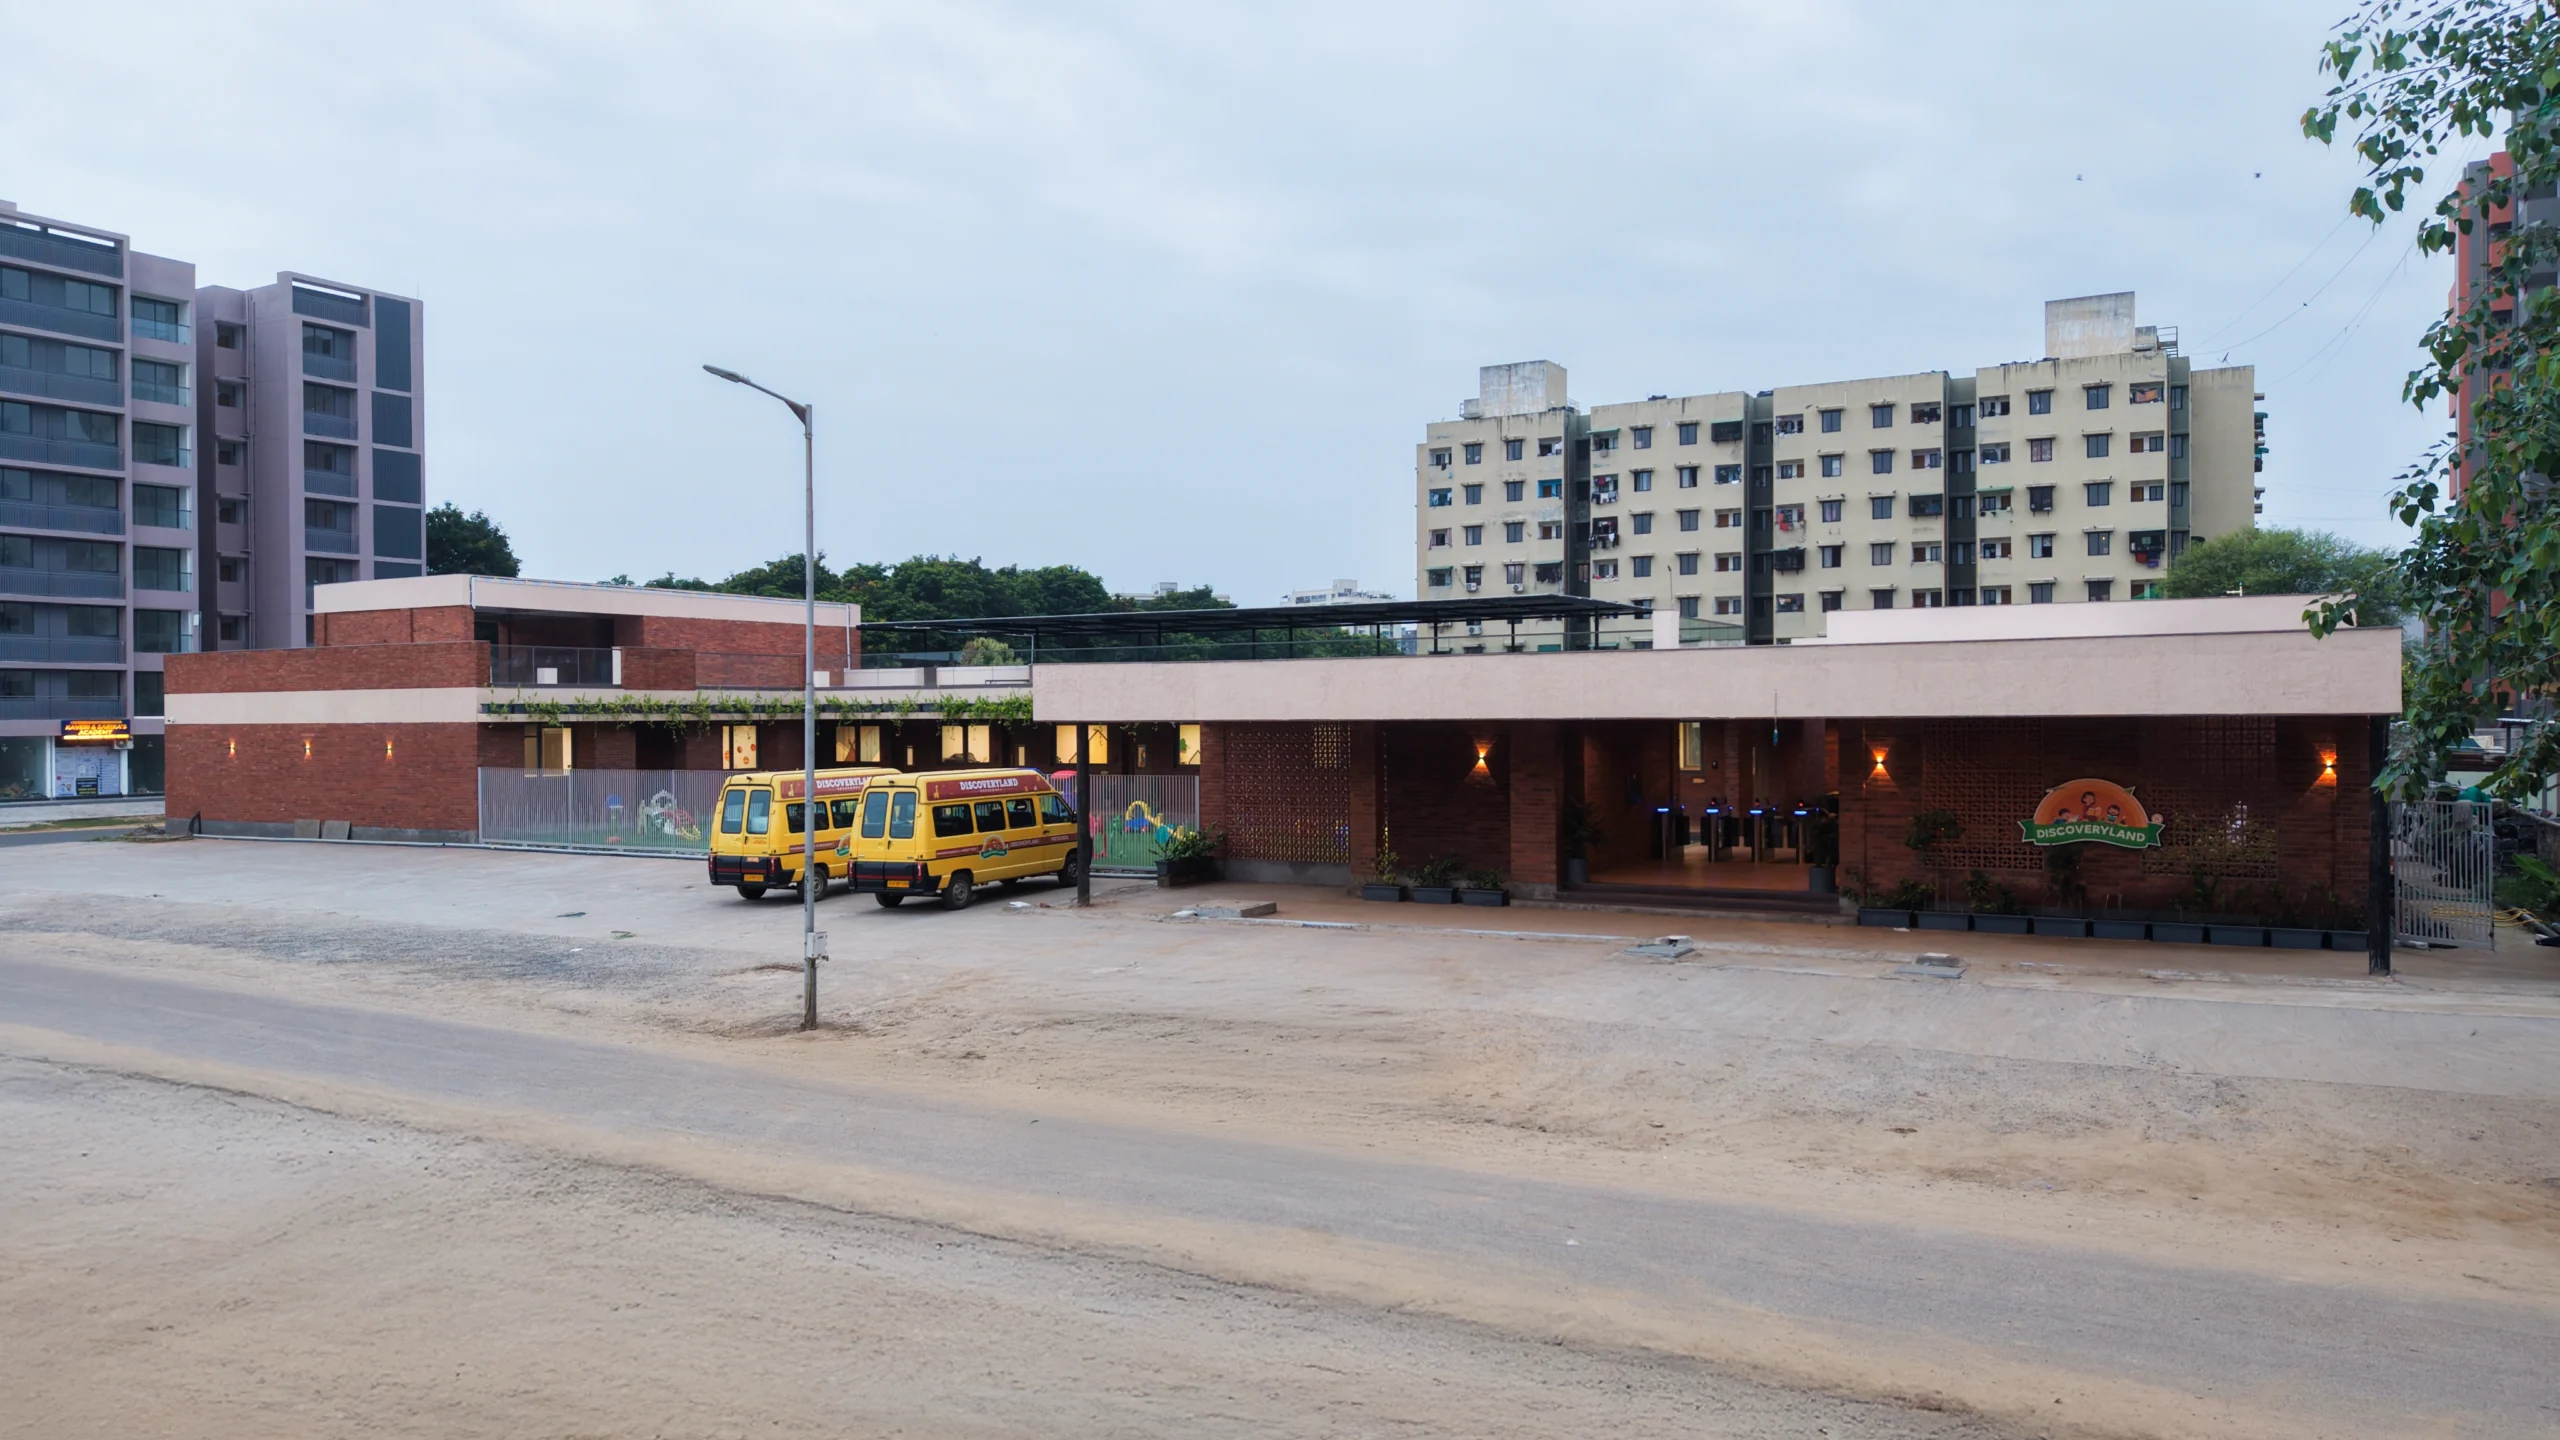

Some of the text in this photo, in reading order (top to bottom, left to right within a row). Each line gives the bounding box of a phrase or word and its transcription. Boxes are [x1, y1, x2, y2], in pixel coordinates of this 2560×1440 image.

[816, 776, 870, 789] DISCOVERYLA
[959, 778, 1018, 790] DISCOVERYLAND
[2036, 824, 2146, 842] DISCOVERYLAND
